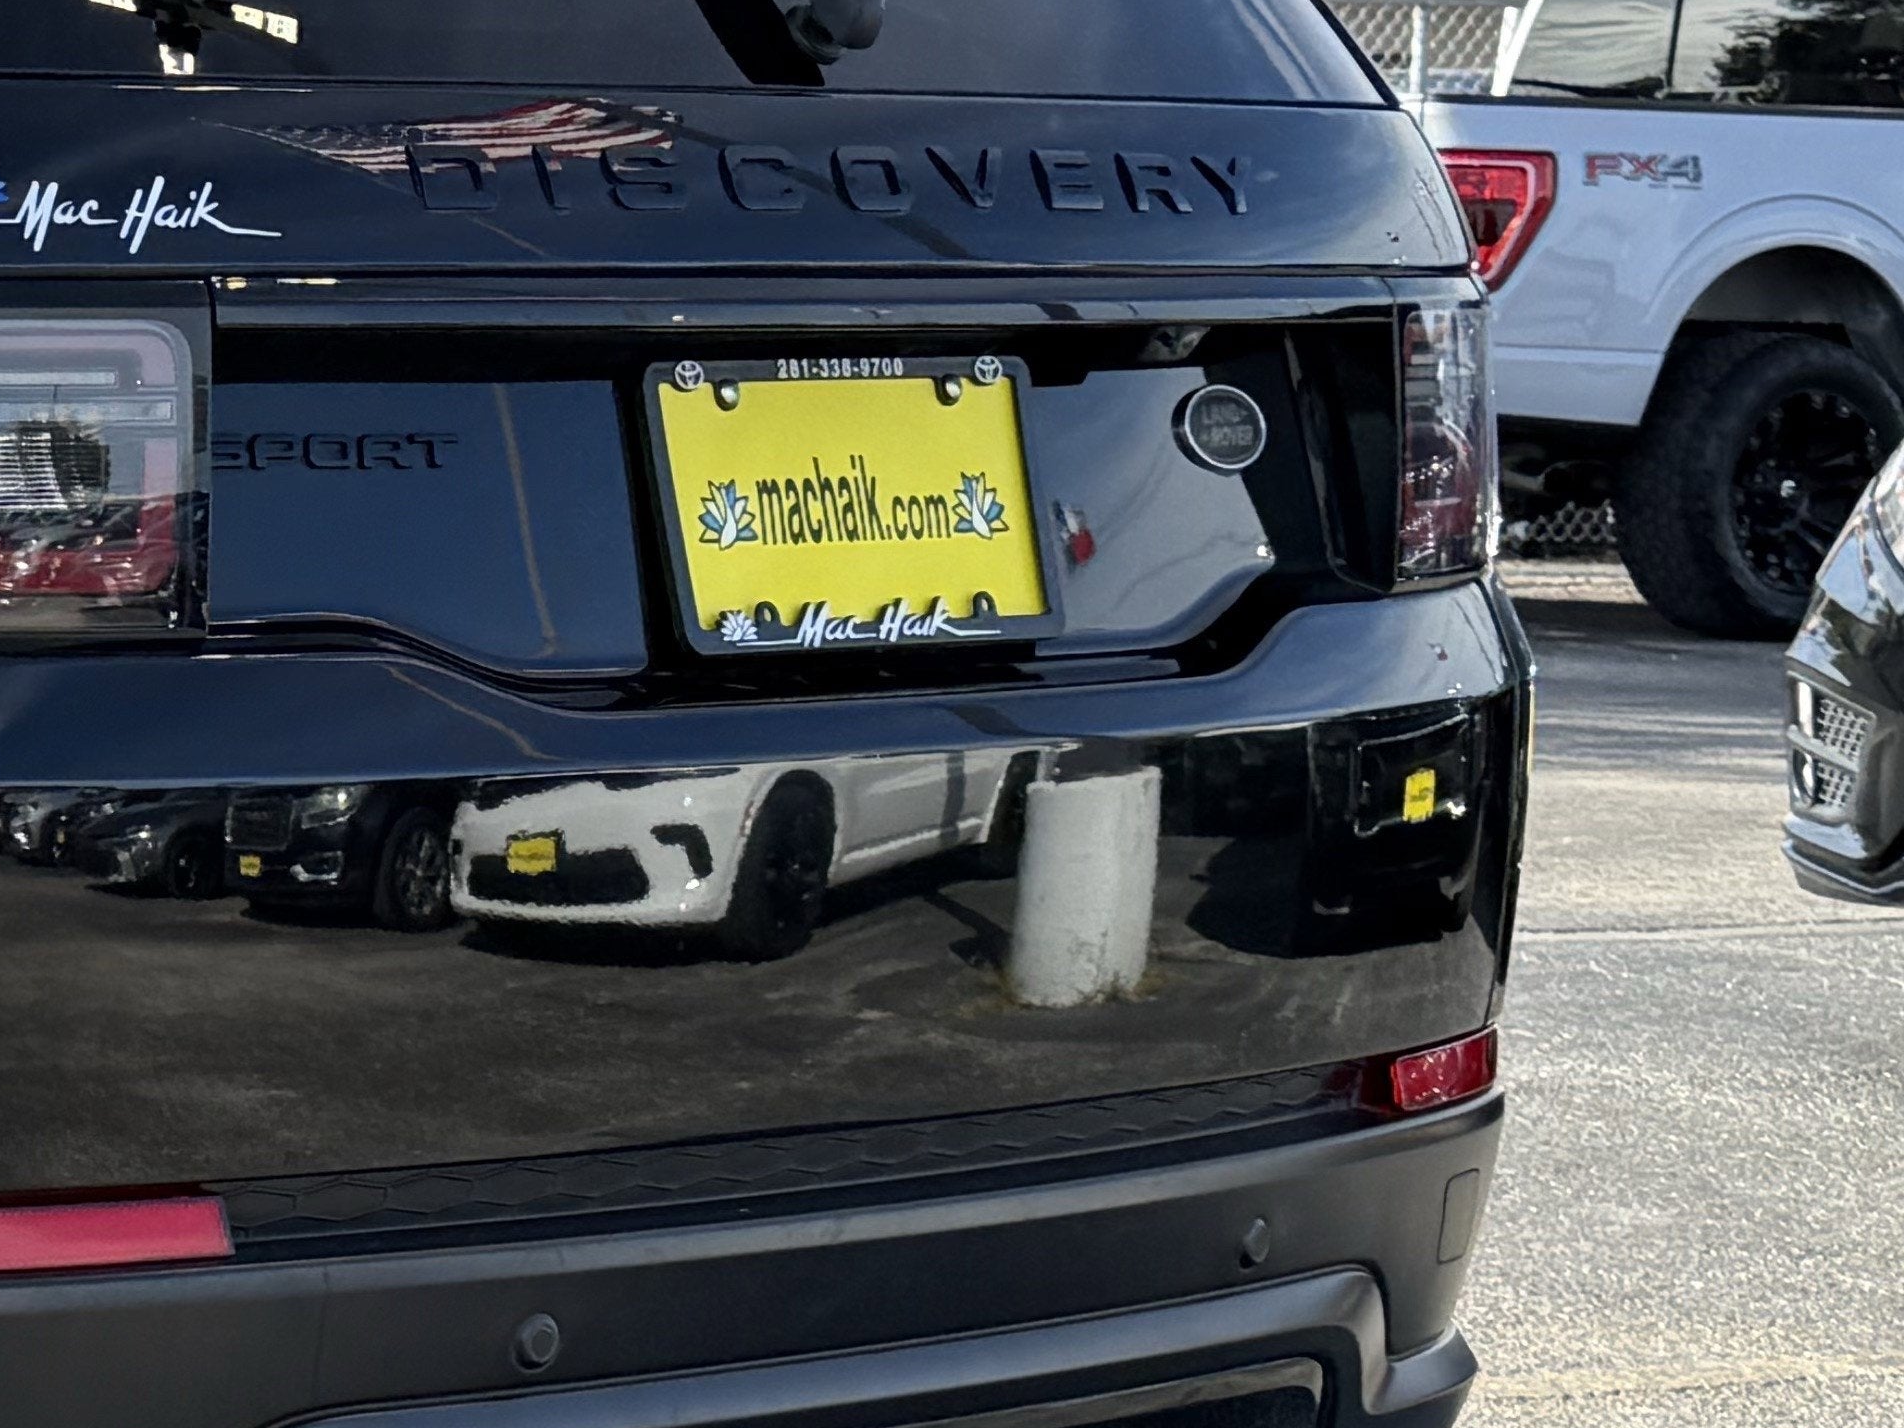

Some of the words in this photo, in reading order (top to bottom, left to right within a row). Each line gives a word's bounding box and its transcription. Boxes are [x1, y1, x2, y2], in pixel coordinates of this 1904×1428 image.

[405, 143, 1254, 215] DISCOVERY
[1582, 152, 1704, 190] FX4
[119, 175, 283, 254] Haik
[755, 454, 952, 546] machaik.com
[736, 601, 878, 648] Mac
[878, 596, 1002, 640] Haik
